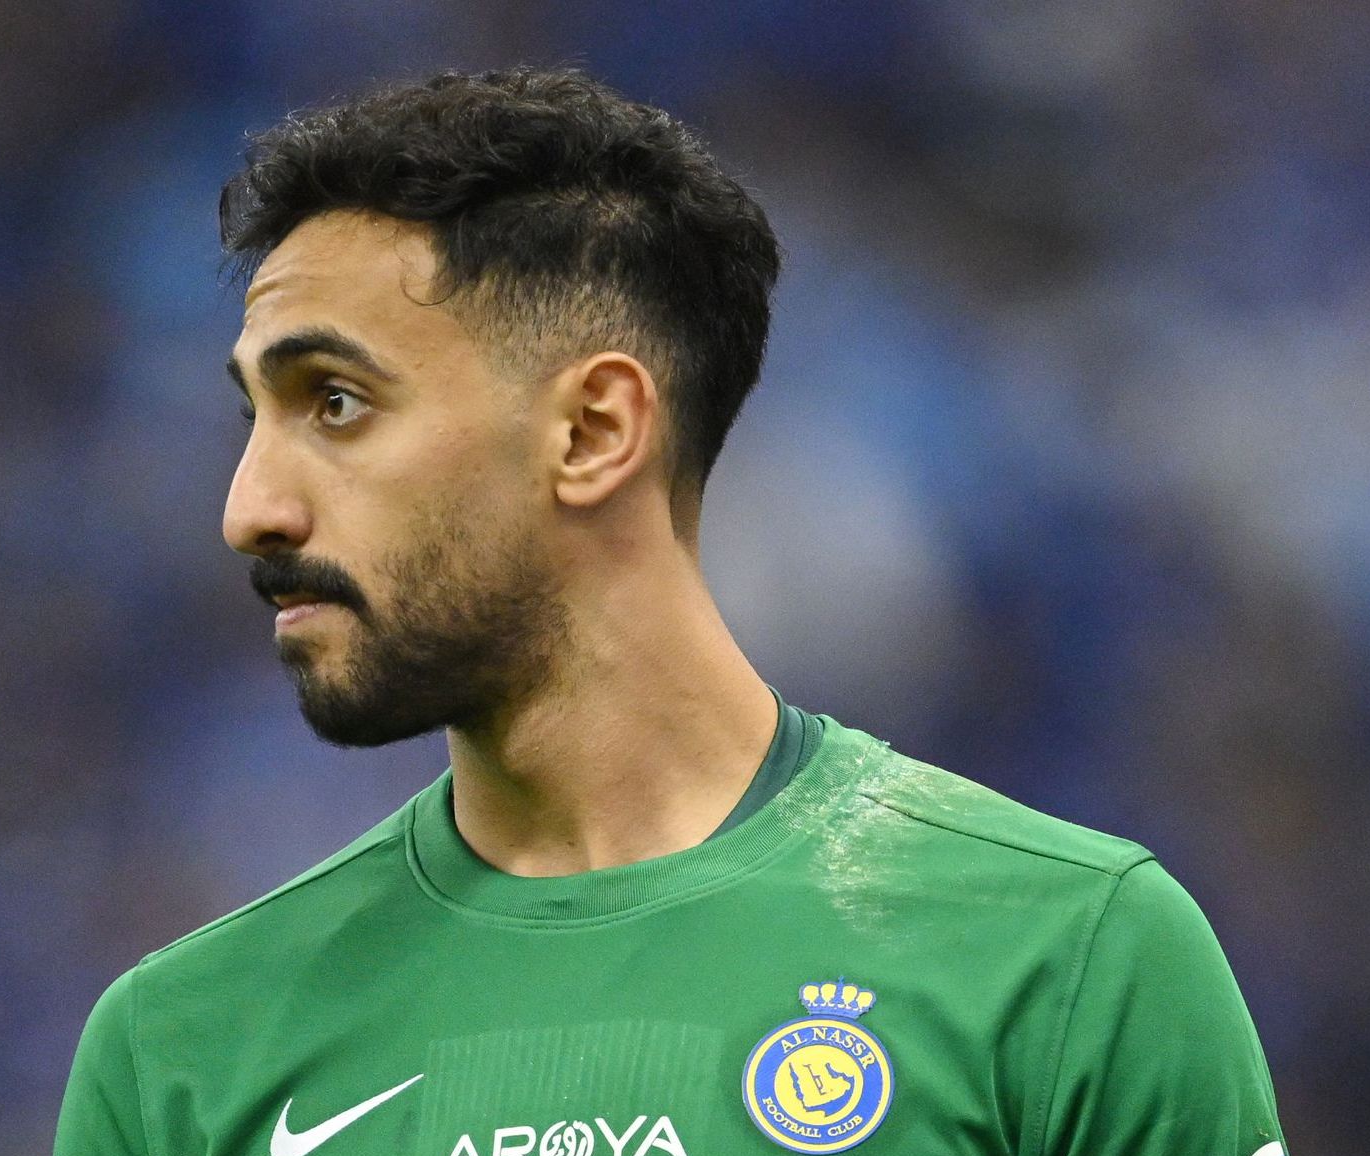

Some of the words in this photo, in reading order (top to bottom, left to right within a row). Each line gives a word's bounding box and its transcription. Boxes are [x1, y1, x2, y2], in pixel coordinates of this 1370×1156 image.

[780, 1032, 808, 1054] AL
[812, 1027, 877, 1070] NASSR
[762, 1096, 822, 1138] FOOTBALL
[827, 1114, 863, 1138] CLUB
